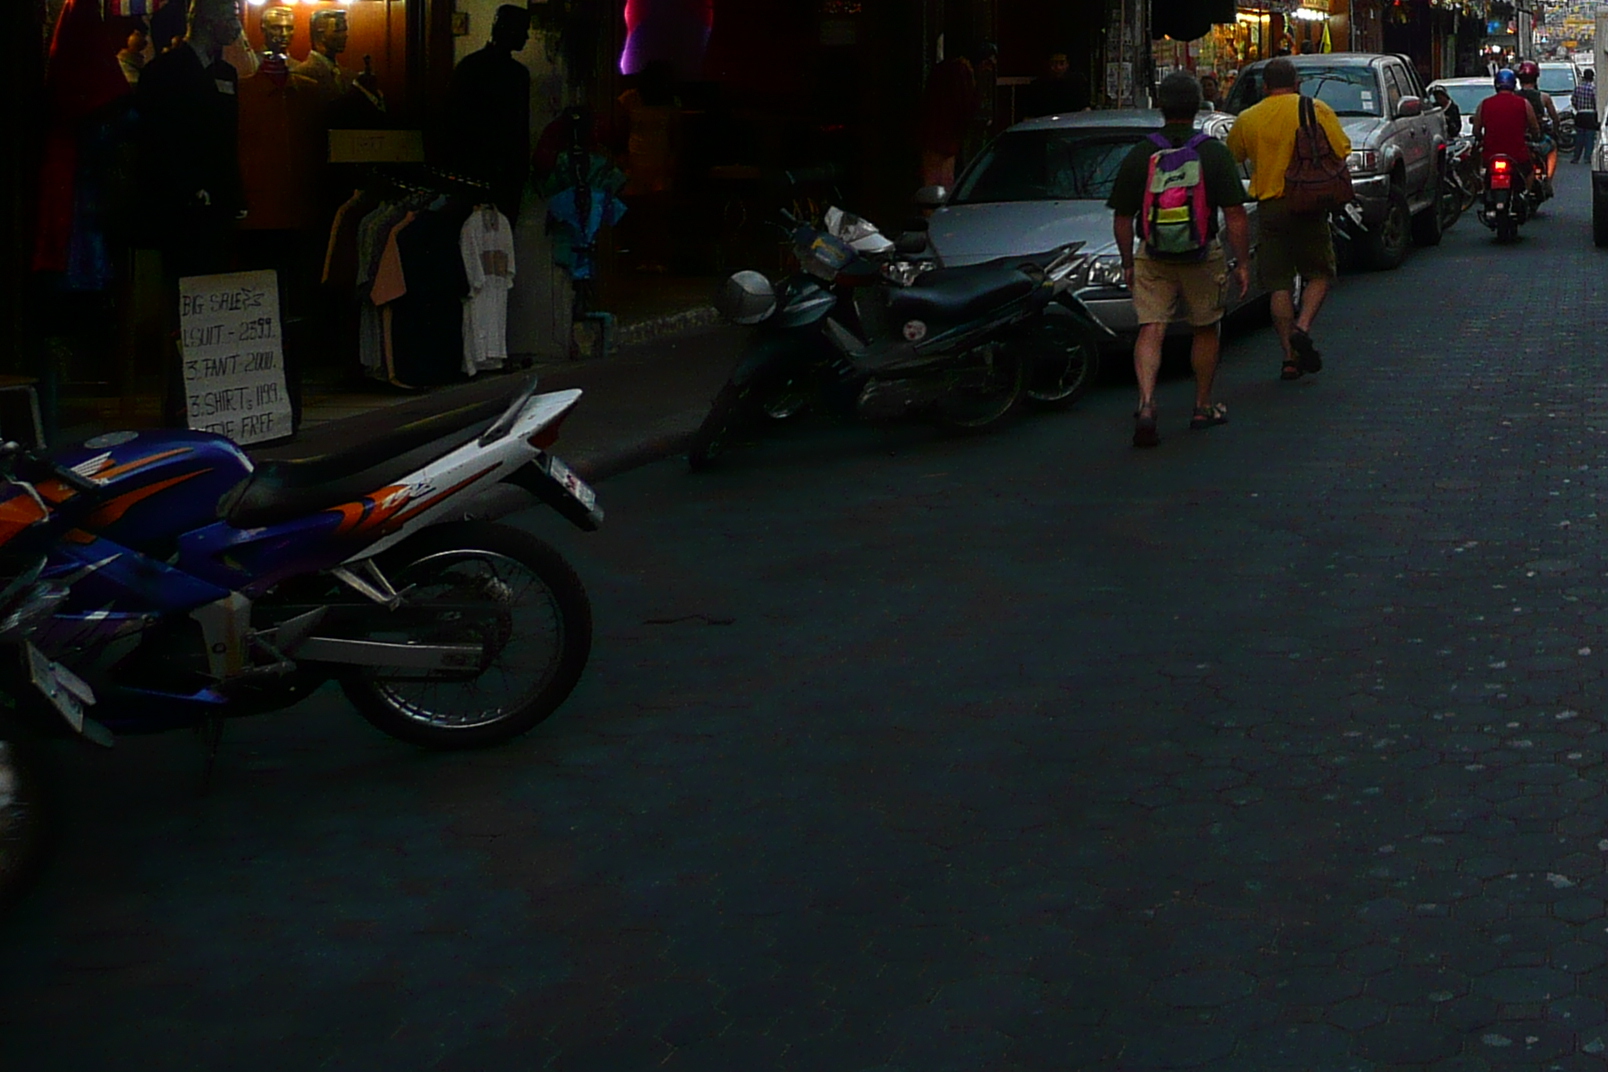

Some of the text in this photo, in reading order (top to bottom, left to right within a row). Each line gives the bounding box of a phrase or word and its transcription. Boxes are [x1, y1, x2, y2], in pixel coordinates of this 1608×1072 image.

[182, 292, 242, 317] BIG SALE
[241, 411, 275, 439] FREE
